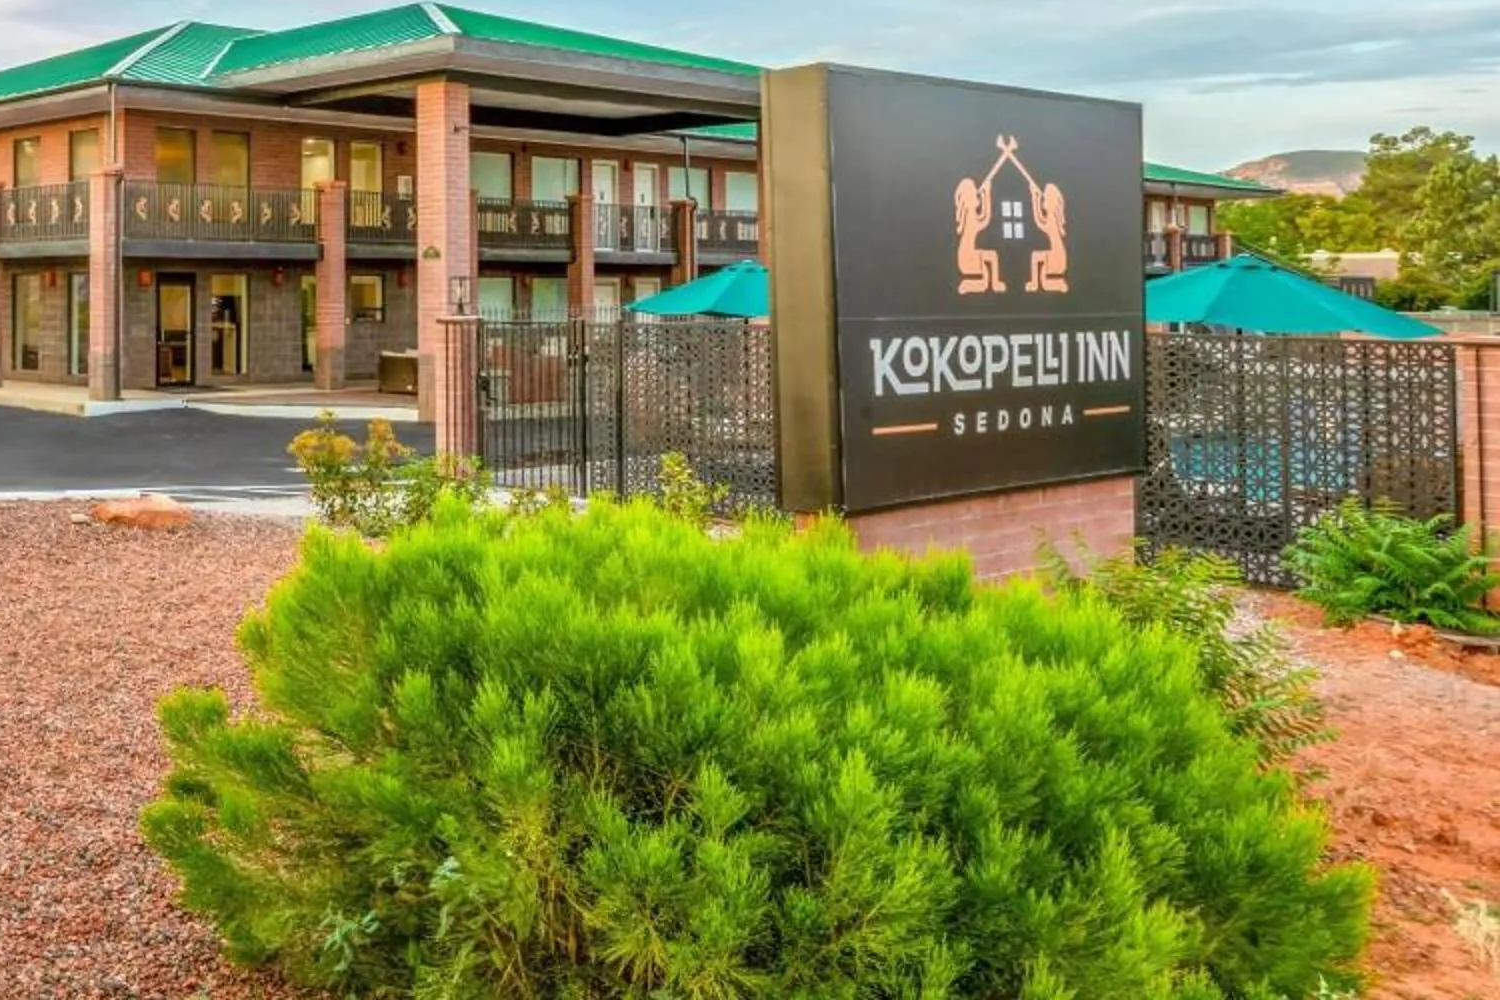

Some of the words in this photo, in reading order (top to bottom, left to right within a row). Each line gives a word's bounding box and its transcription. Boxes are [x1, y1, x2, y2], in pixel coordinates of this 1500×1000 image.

[870, 332, 1068, 396] KOKOPELLI
[1076, 330, 1131, 383] INN
[953, 404, 1074, 435] SEDONA
